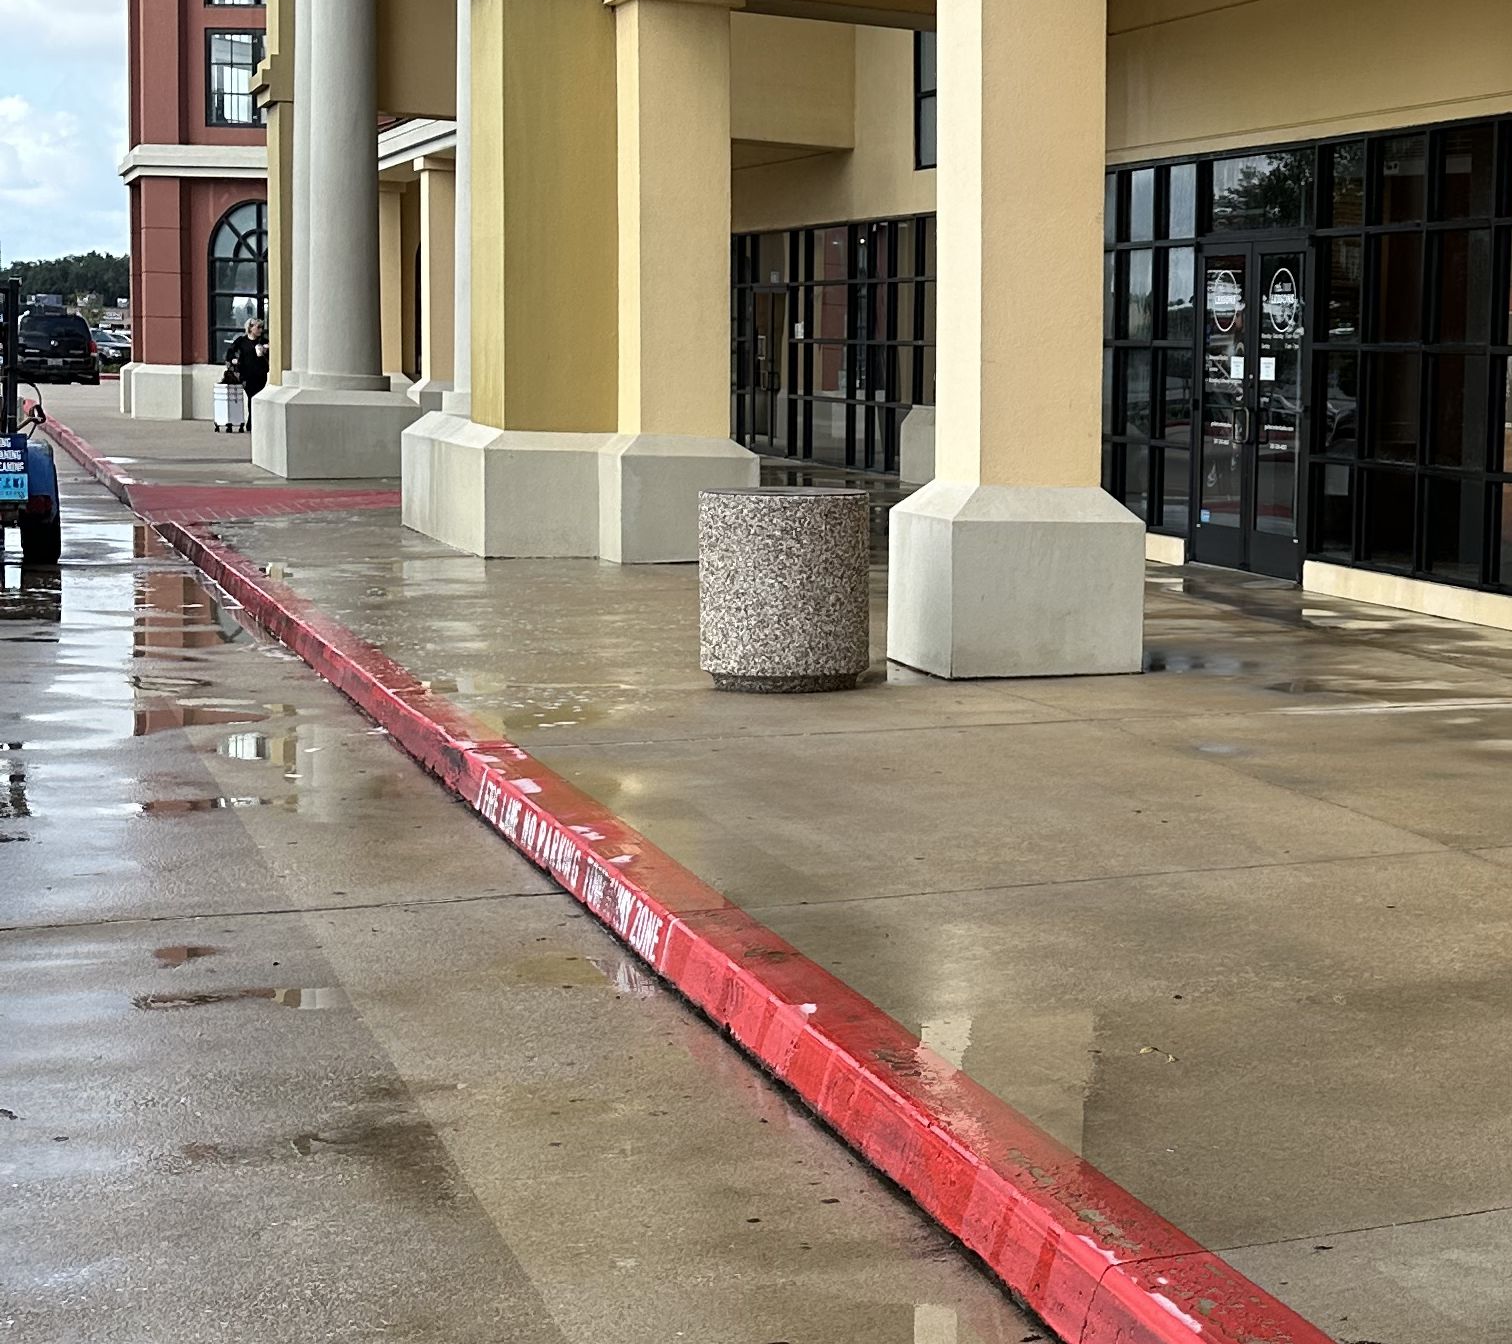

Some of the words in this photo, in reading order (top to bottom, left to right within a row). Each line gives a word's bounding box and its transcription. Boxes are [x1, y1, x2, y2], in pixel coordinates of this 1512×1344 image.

[521, 808, 538, 850] NO
[535, 819, 582, 888] PARKING
[629, 900, 663, 963] ZONE
